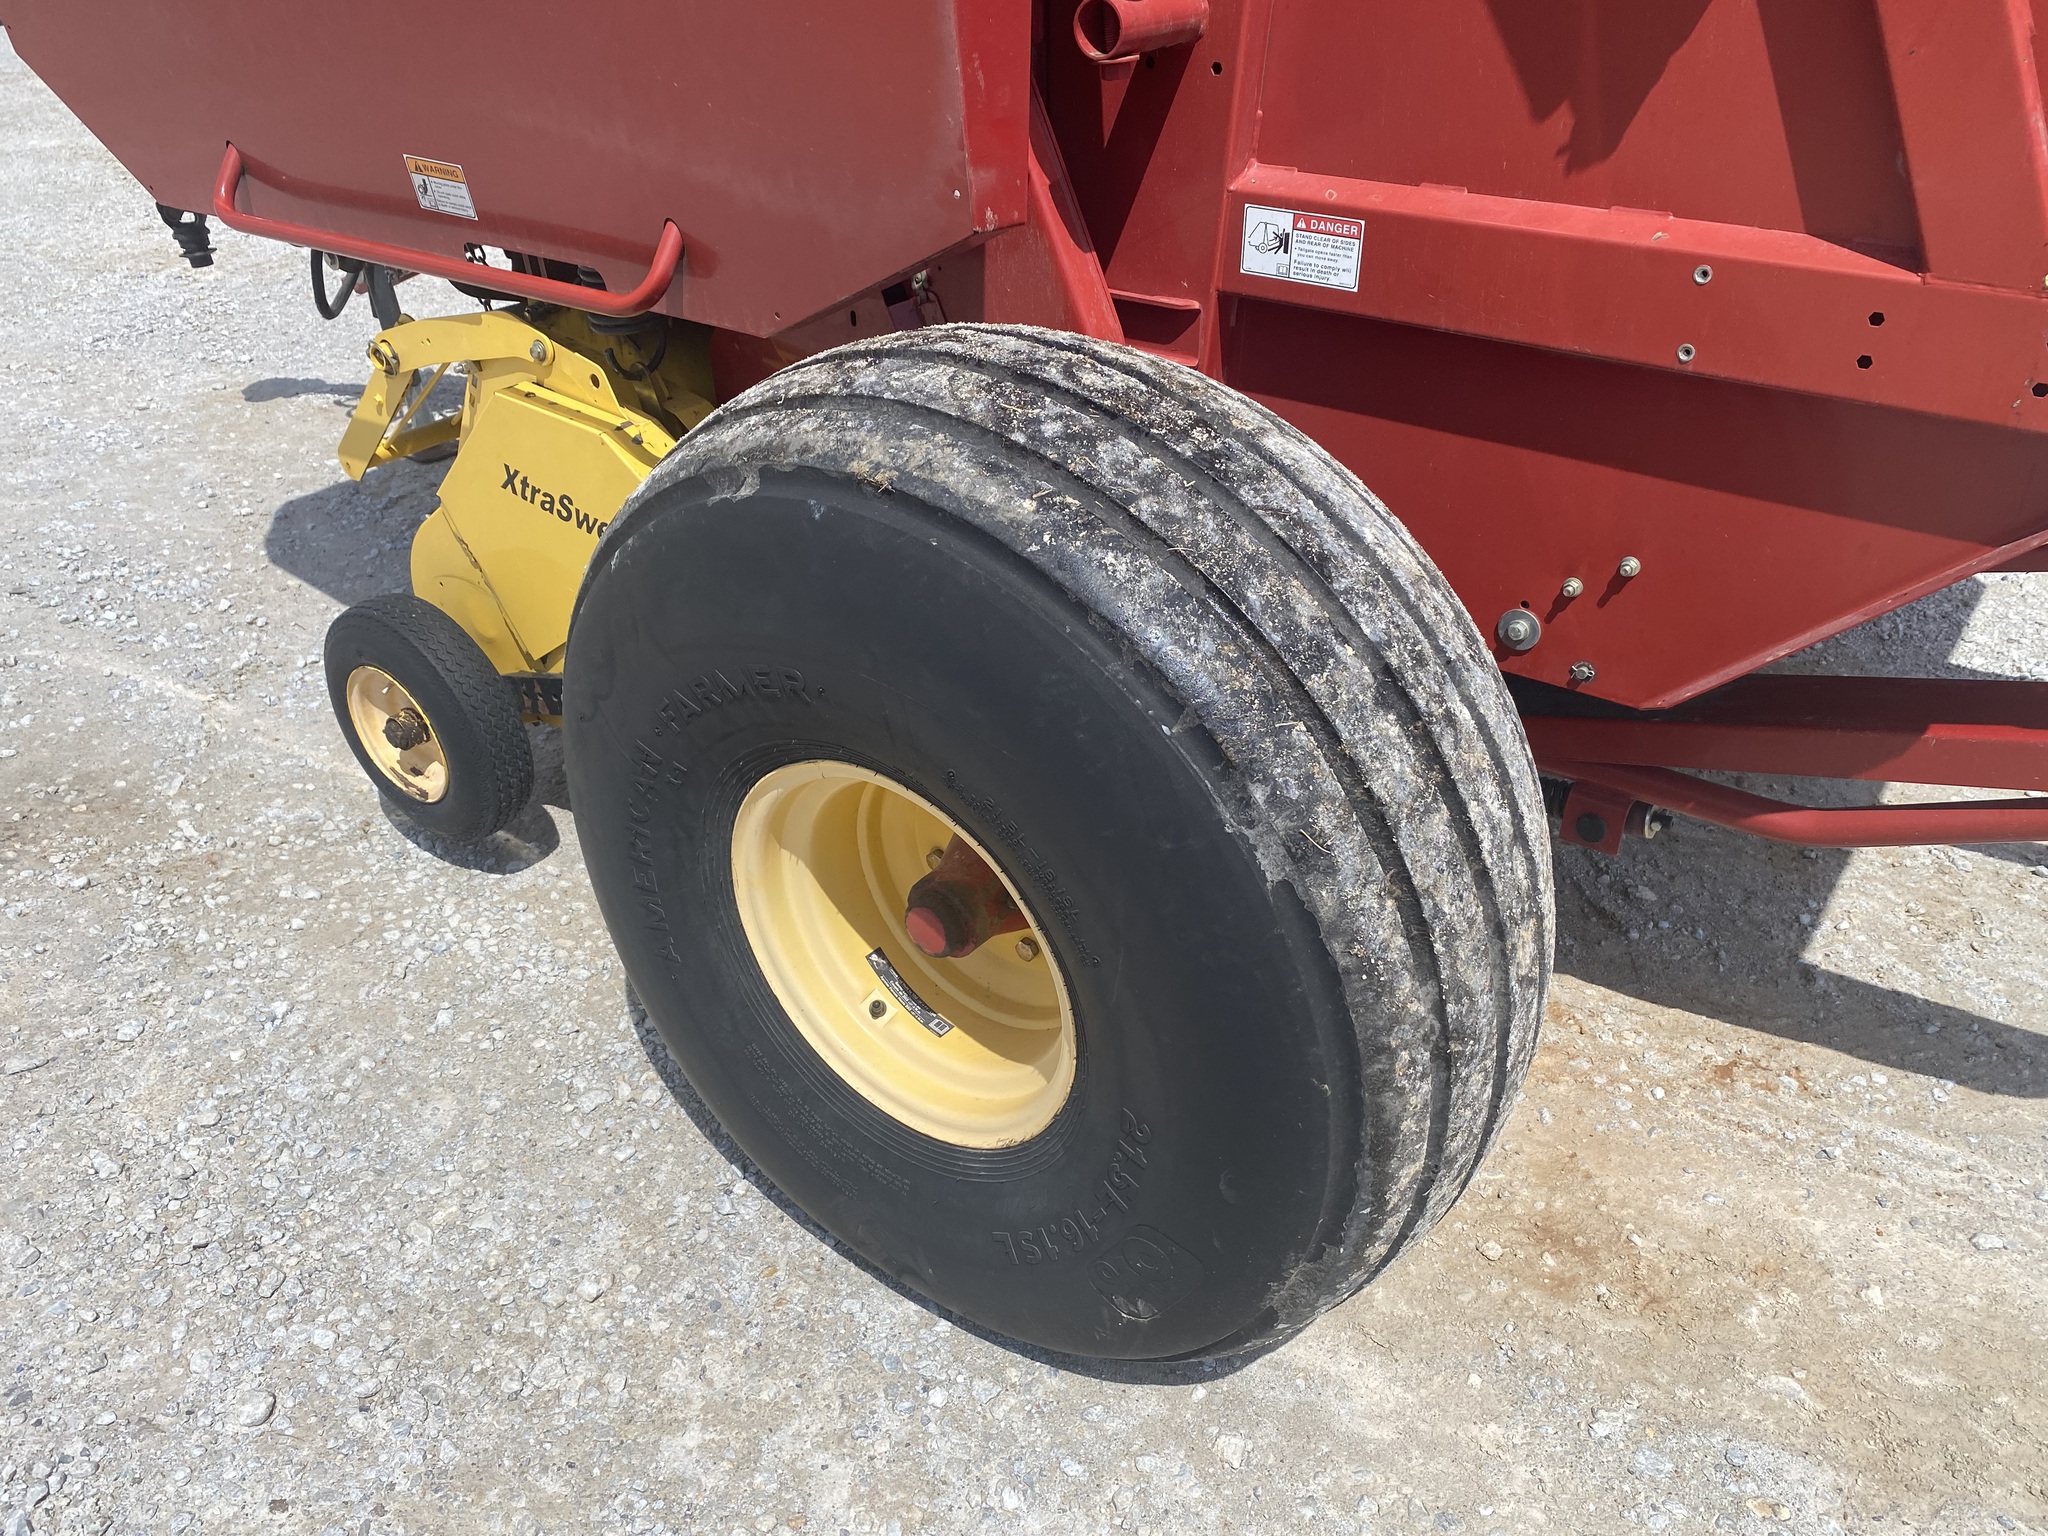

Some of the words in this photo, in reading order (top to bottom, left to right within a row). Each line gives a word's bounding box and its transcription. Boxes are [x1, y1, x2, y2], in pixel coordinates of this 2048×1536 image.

[422, 164, 459, 178] WARNING
[1310, 220, 1358, 236] DANGER
[1330, 244, 1354, 252] MACHINE
[624, 737, 682, 964] AMERICAN
[654, 663, 818, 737] FARMER
